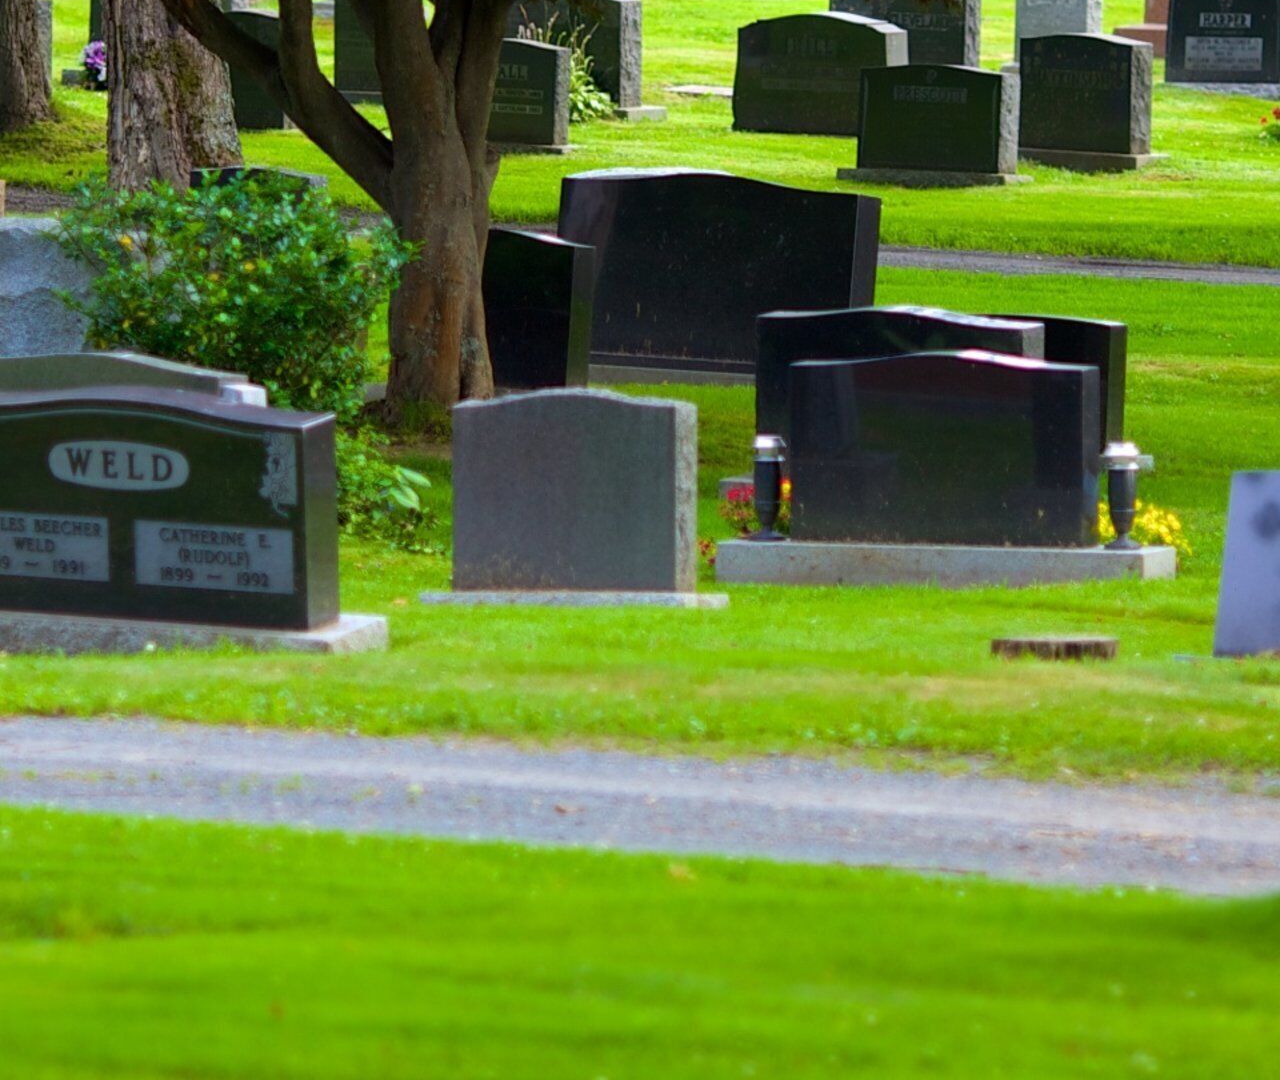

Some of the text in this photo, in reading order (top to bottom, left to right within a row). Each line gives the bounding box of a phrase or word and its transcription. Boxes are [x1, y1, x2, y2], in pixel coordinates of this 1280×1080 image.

[1204, 14, 1246, 26] HARPER
[66, 447, 173, 482] WELD
[34, 518, 101, 537] BEECHER
[14, 536, 55, 553] WELD
[159, 527, 271, 549] CATHERINE E.
[53, 558, 85, 574] 1991
[178, 547, 250, 567] (RUDOLF)
[160, 566, 194, 583] 1899
[236, 571, 269, 588] 1992
